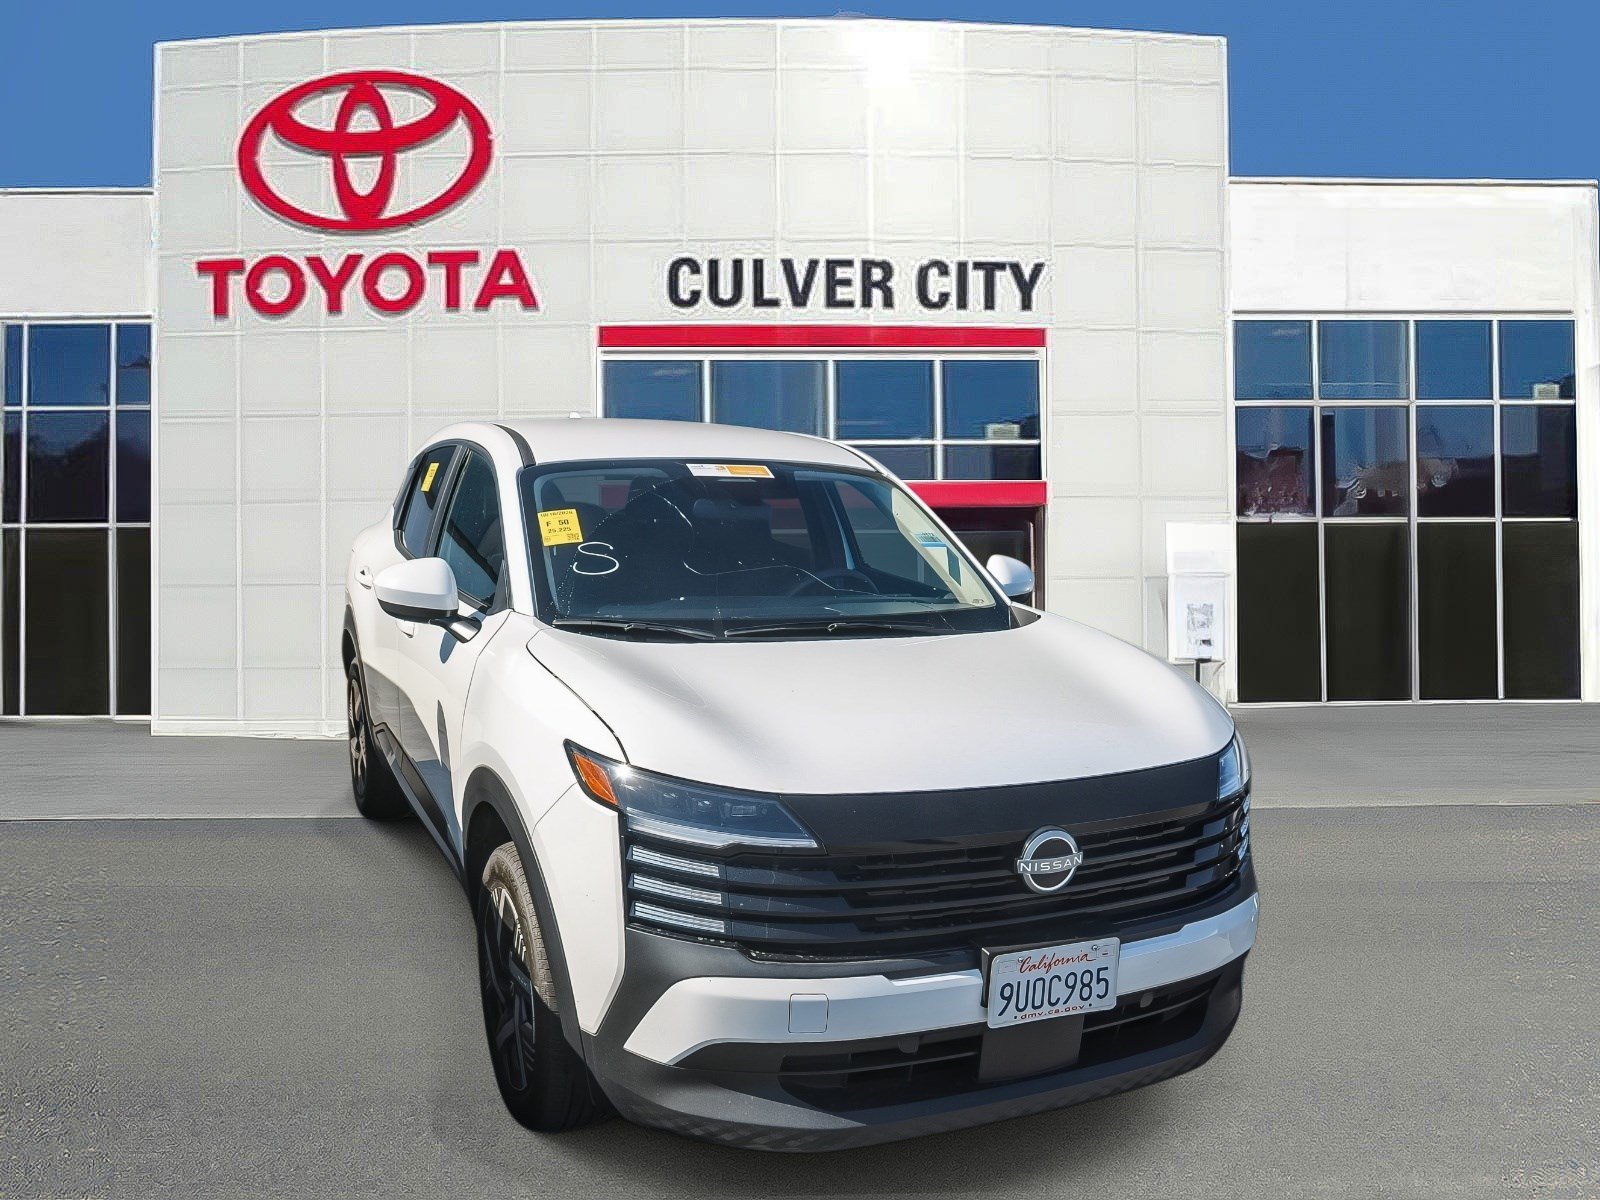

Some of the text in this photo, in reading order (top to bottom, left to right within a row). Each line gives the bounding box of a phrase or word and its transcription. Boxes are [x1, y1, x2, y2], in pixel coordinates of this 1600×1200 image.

[196, 249, 540, 318] TOYOTA
[668, 258, 1046, 312] CULVER CITY
[572, 541, 620, 576] S
[1019, 854, 1082, 872] NISSAN
[1019, 950, 1097, 974] California
[1020, 1004, 1085, 1020] dmv.ca.gov
